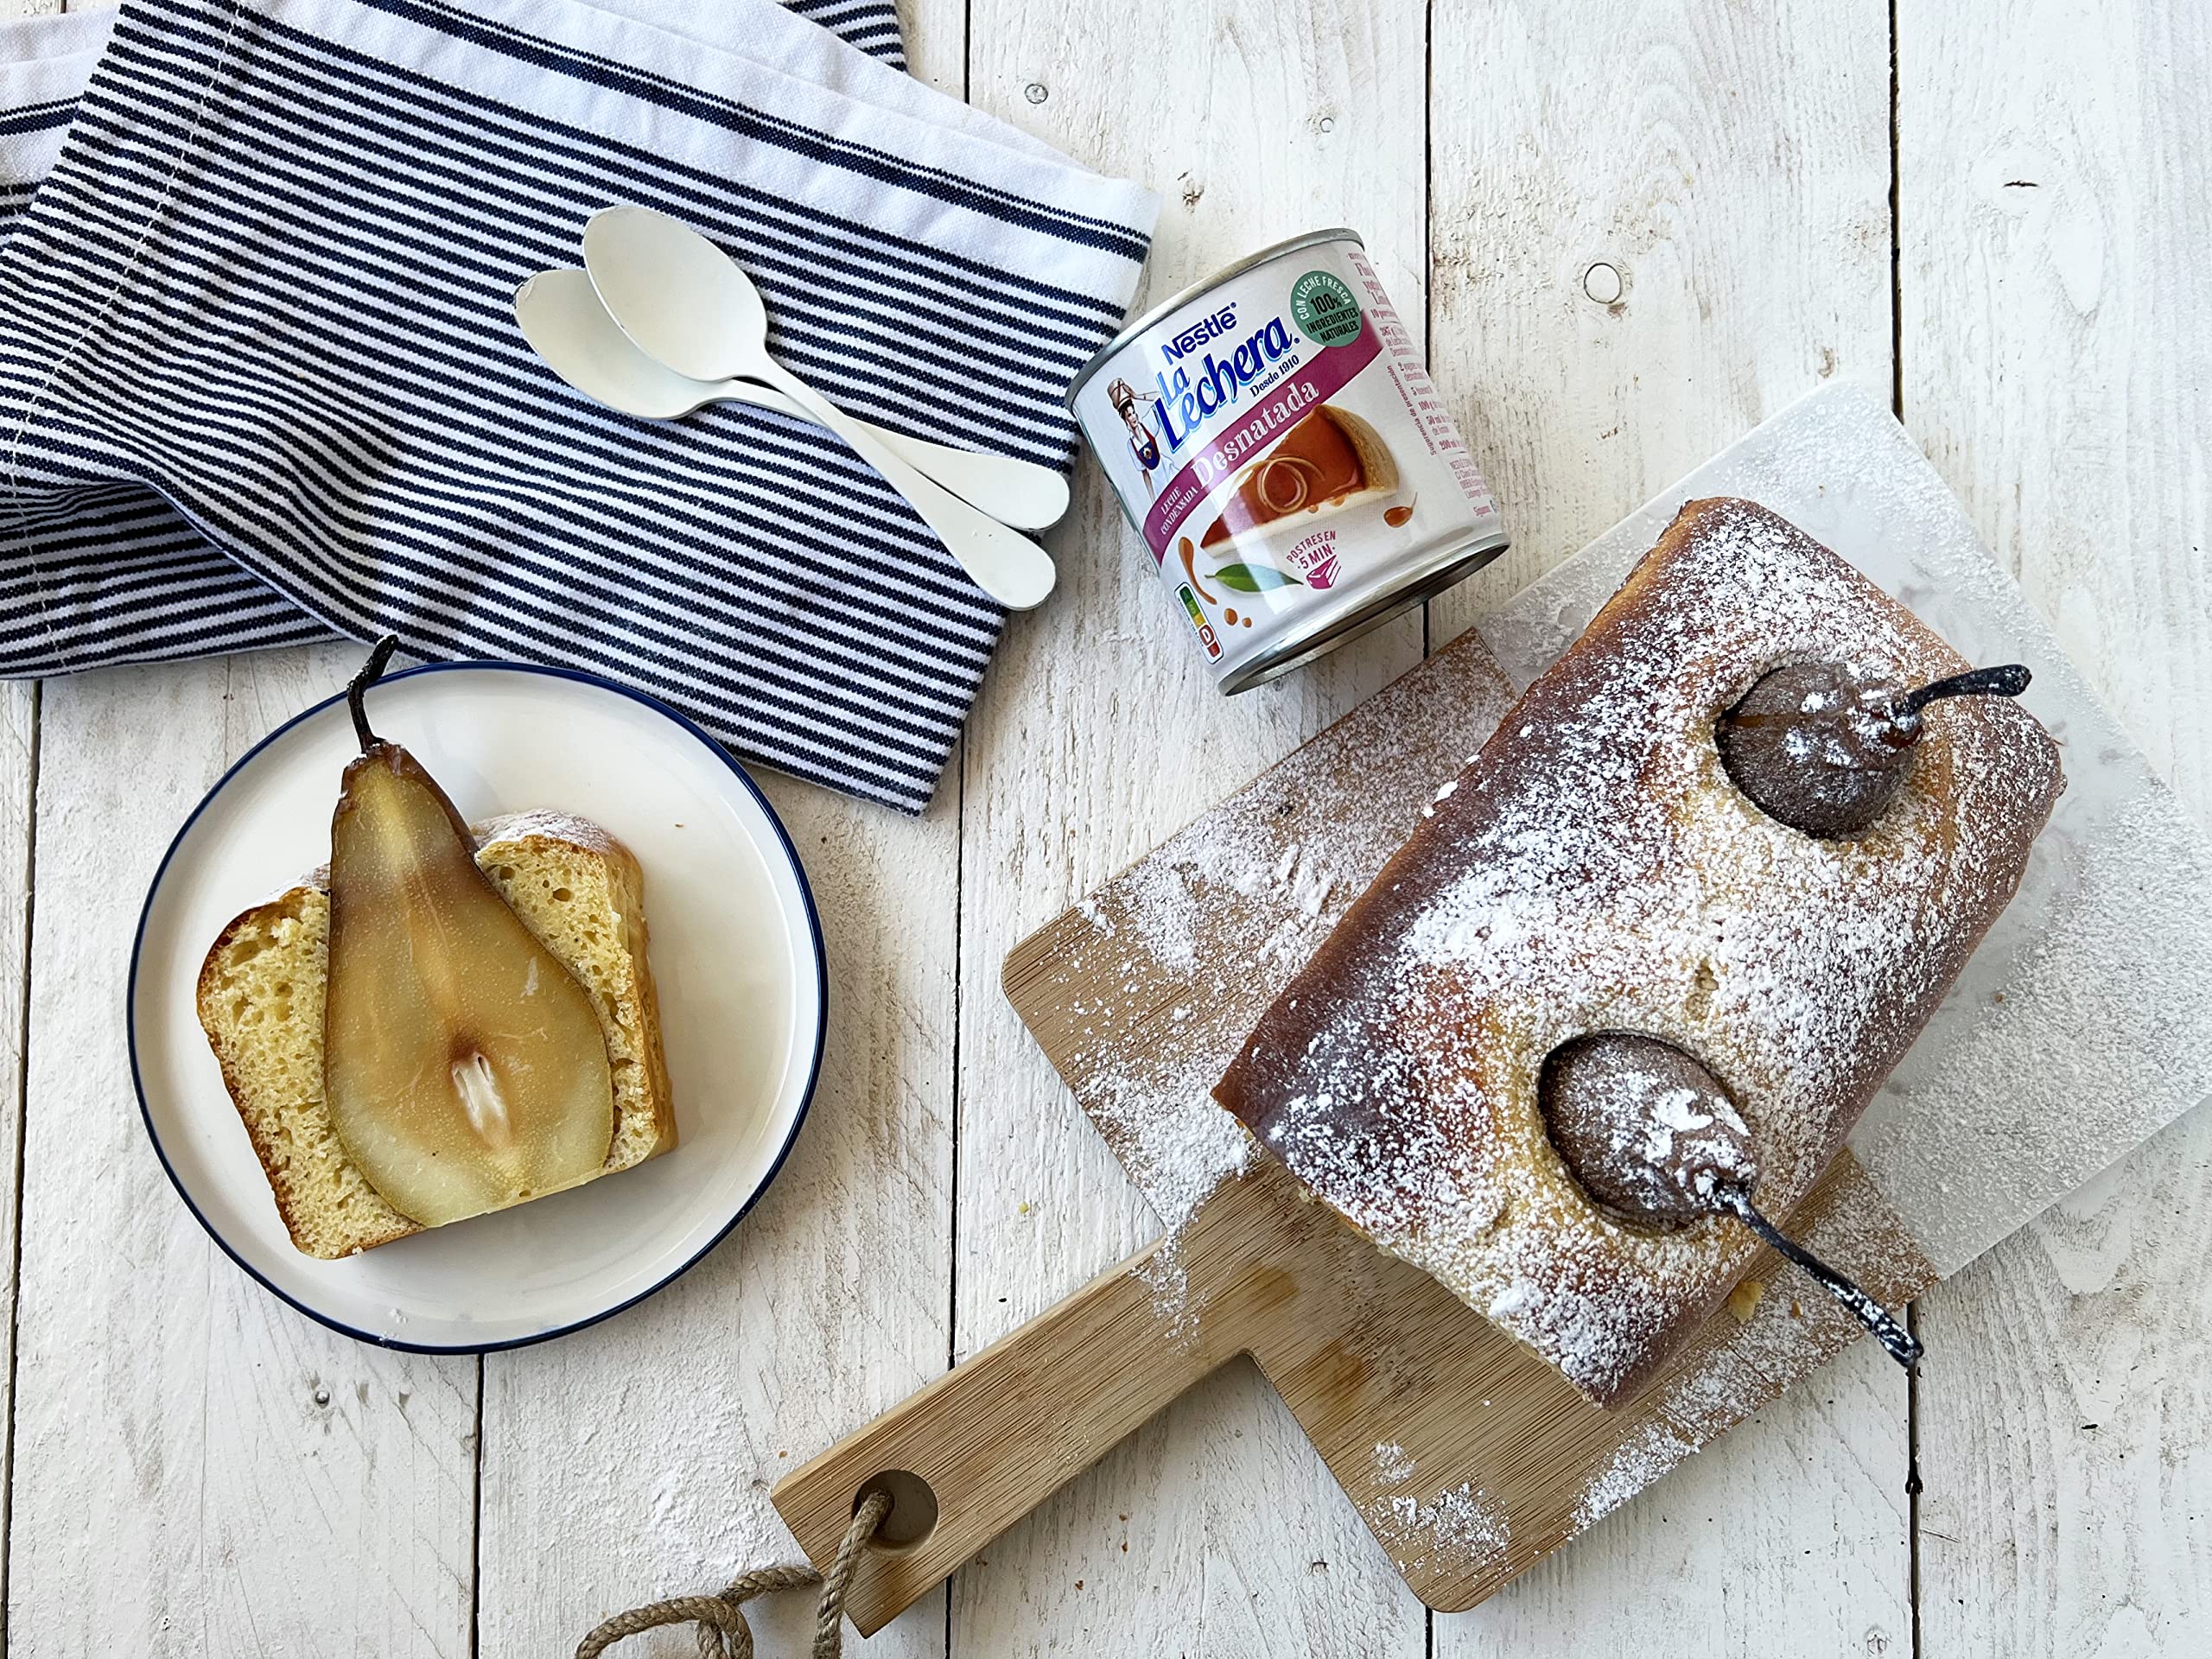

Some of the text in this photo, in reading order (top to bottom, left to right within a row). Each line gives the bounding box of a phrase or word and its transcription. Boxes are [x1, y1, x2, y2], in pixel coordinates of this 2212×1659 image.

[1297, 276, 1321, 298] LECHE
[1322, 276, 1351, 305] FRESCA
[1296, 300, 1310, 320] CON
[1310, 293, 1342, 315] 100%
[1306, 308, 1358, 334] INGREDIENTES
[1319, 321, 1359, 342] NATURALES
[1278, 354, 1300, 375] 1910
[1153, 316, 1294, 453] Lechera
[1155, 366, 1190, 409] La
[1190, 382, 1319, 490] Desnatada
[1160, 486, 1182, 515] LECHE
[1160, 486, 1198, 535] CONDENSADA
[1287, 531, 1336, 563] POSTRES EN
[1201, 628, 1212, 643] D
